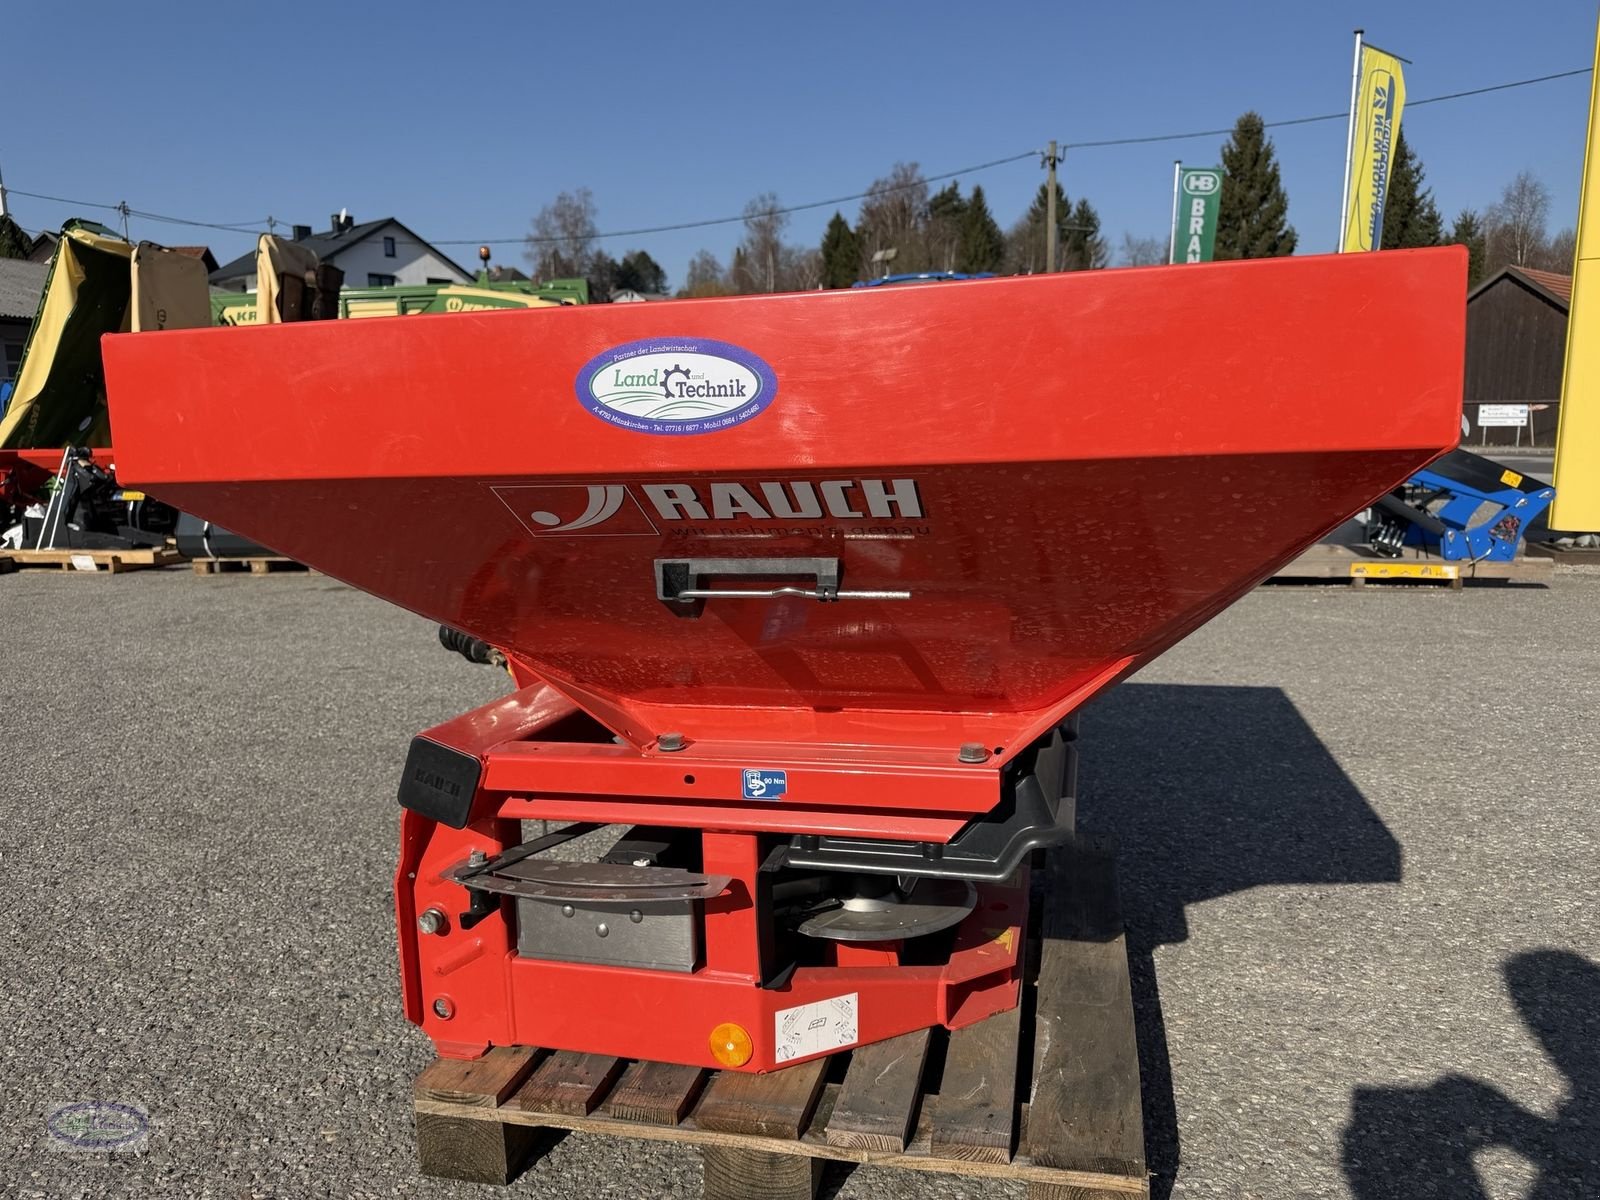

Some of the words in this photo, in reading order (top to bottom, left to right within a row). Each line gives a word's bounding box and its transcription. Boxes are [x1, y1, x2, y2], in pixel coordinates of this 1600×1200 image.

[613, 350, 637, 362] Partner
[637, 347, 649, 355] der
[649, 344, 698, 353] Landwirtschaft
[613, 368, 659, 387] Land
[675, 379, 746, 398] Technik
[703, 420, 721, 430] Mobil
[641, 479, 923, 519] RAUCH
[669, 525, 708, 537] wir
[415, 768, 461, 797] RAUCH
